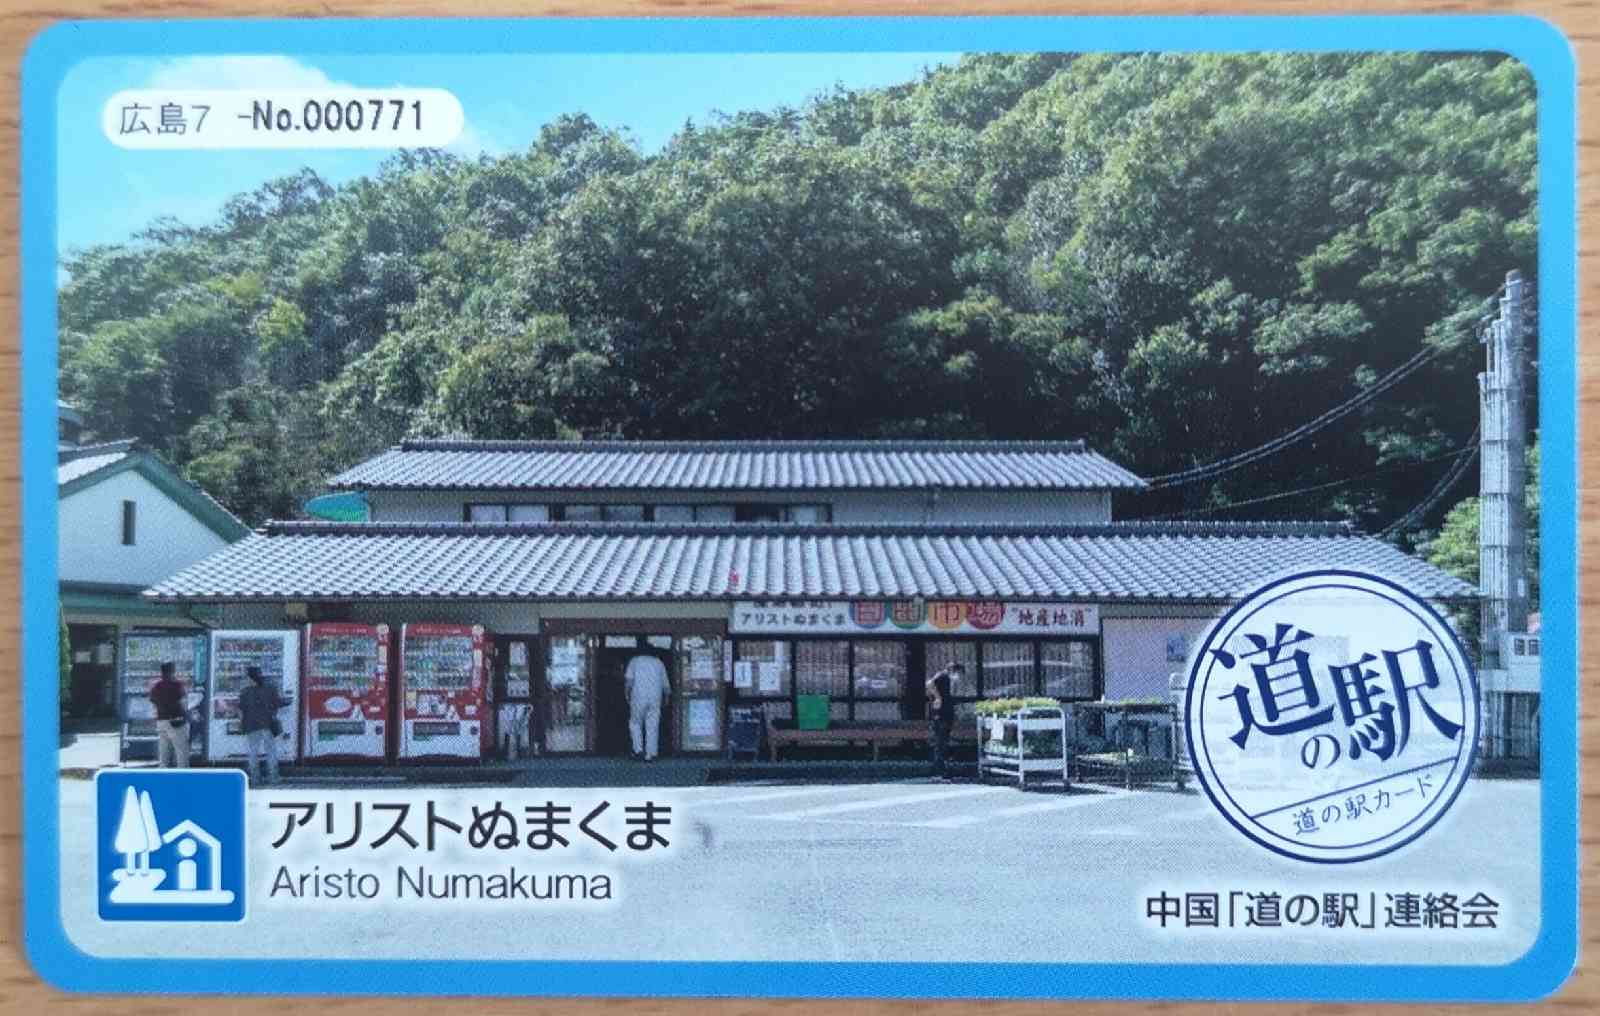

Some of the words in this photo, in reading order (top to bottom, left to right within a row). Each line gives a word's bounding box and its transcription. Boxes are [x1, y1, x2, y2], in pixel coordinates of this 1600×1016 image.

[119, 102, 211, 136] 広島7
[1292, 775, 1434, 835] 道の駅カード
[269, 800, 672, 852] アリストぬまくま
[270, 865, 380, 899] Aristo
[397, 866, 612, 900] Numakuma
[1146, 891, 1500, 929] 中国「道の駅」連絡会
